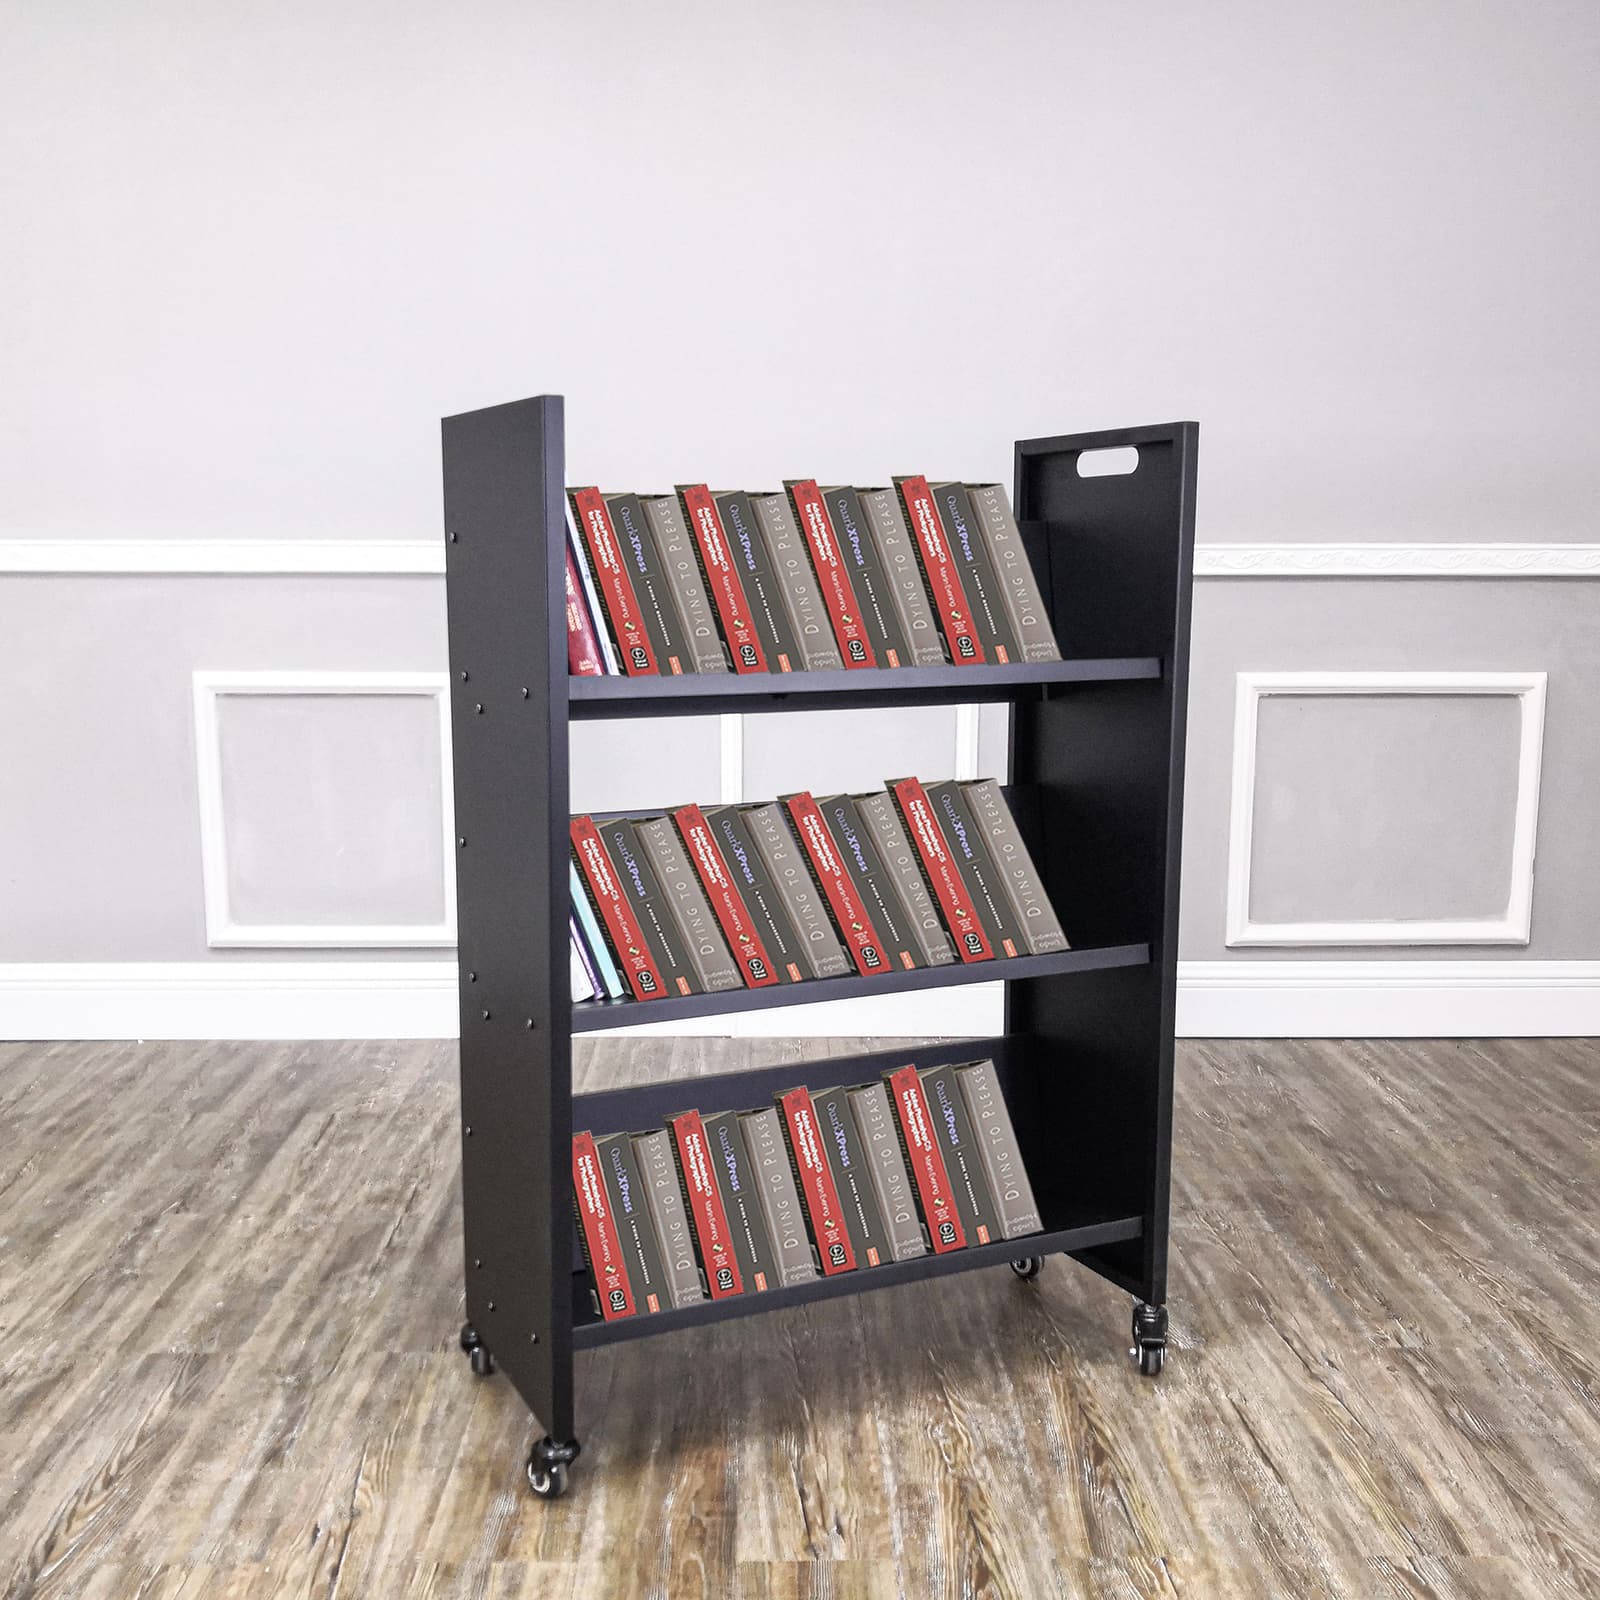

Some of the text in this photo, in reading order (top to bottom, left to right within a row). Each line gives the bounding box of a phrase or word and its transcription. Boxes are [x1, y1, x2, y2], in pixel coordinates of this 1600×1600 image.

[618, 505, 648, 573] QuarkXPress
[656, 500, 682, 552] PLEASE
[728, 503, 757, 570] QuarkXPress
[765, 498, 791, 550] PLEASE
[836, 498, 865, 565] QuarkXPress
[873, 493, 899, 545] PLEASE
[945, 494, 974, 562] QuarkXPress
[983, 489, 1008, 541] PLEASE
[676, 561, 691, 579] TO
[785, 558, 800, 577] TO
[893, 553, 909, 572] TO
[1003, 550, 1018, 568] TO
[685, 587, 710, 637] DYING
[794, 585, 819, 635] DYING
[902, 580, 927, 630] DYING
[1012, 577, 1037, 627] DYING
[756, 809, 787, 860] PLEASE
[869, 797, 900, 848] PLEASE
[939, 792, 974, 859] QuarkXPress
[976, 784, 1006, 835] PLEASE
[612, 831, 647, 897] QuarkXPress
[649, 822, 679, 873] PLEASE
[719, 818, 756, 884] QuarkXPress
[832, 806, 869, 872] QuarkXPress
[896, 855, 913, 874] TO
[1001, 843, 1018, 862] TO
[674, 880, 691, 899] TO
[783, 867, 800, 886] TO
[1012, 869, 1041, 918] DYING
[795, 892, 825, 942] DYING
[908, 880, 938, 930] DYING
[685, 906, 715, 956] DYING
[825, 1101, 851, 1167] QuarkXPress
[933, 1079, 960, 1145] QuarkXPress
[971, 1067, 1020, 1202] DYING TO PLEASE
[609, 1146, 633, 1213] QuarkXPress
[716, 1125, 740, 1191] QuarkXPress
[754, 1114, 799, 1250] DYING TO PLEASE
[863, 1089, 910, 1224] DYING TO PLEASE
[647, 1136, 691, 1272] DYING TO PLEASE
